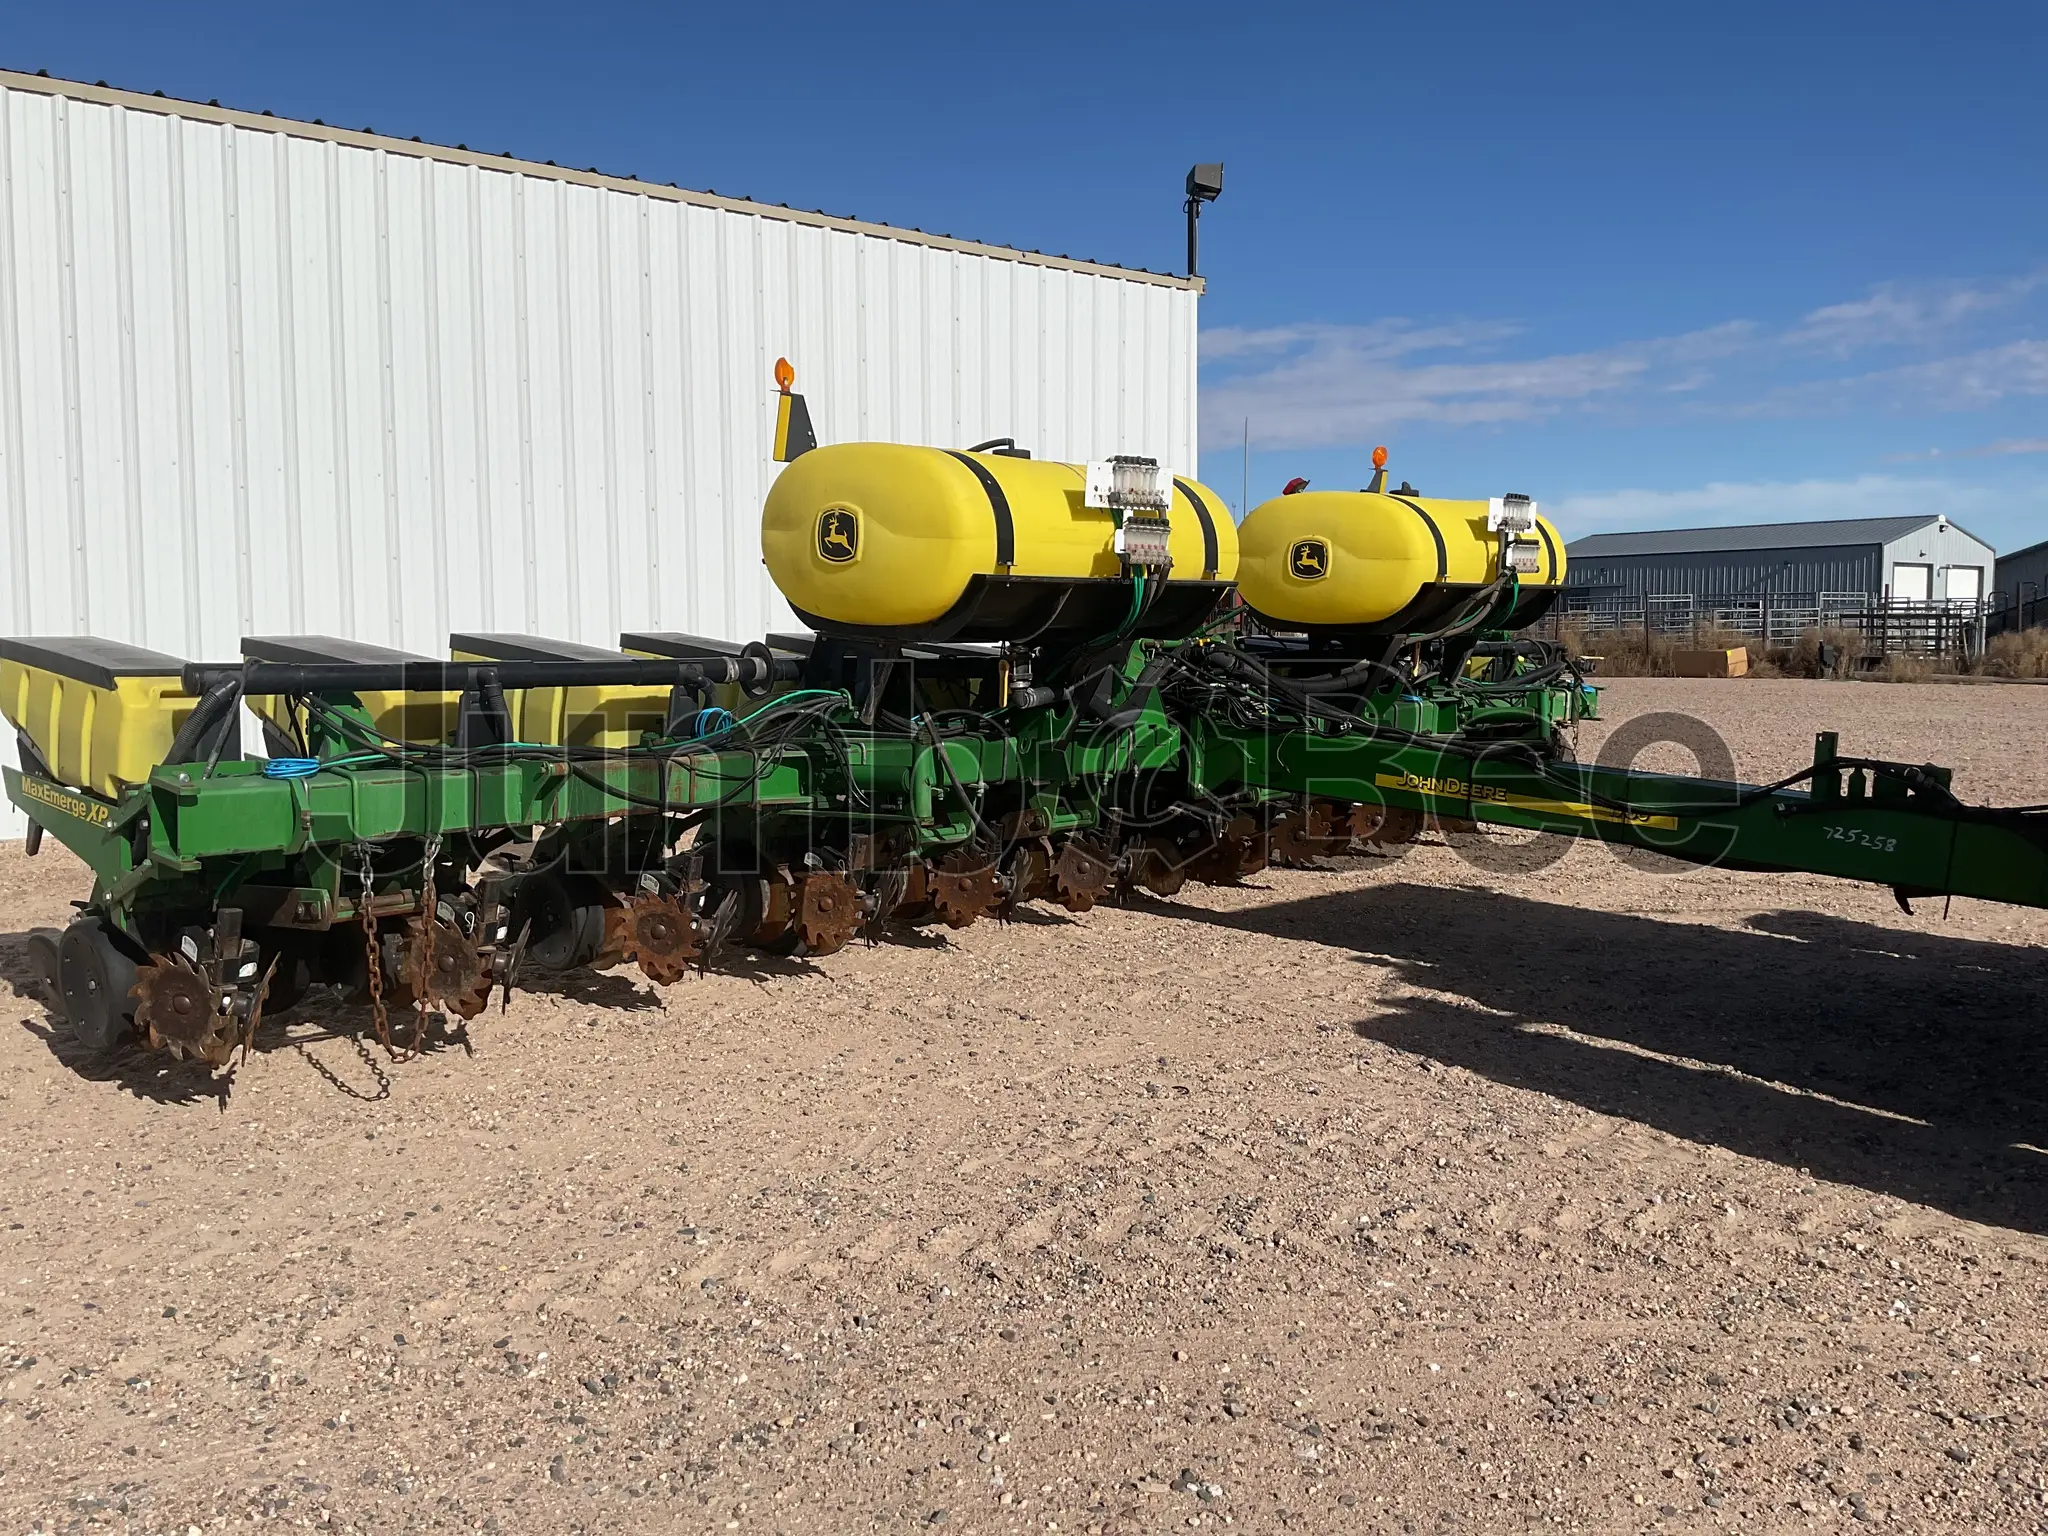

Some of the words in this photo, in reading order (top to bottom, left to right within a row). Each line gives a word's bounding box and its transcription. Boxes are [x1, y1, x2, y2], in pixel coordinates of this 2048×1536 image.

[21, 775, 87, 819] MaxEmerge
[86, 802, 109, 823] XP
[1397, 770, 1444, 792] JOHN
[1446, 777, 1507, 801] DEERE
[1822, 826, 1897, 852] 725258
